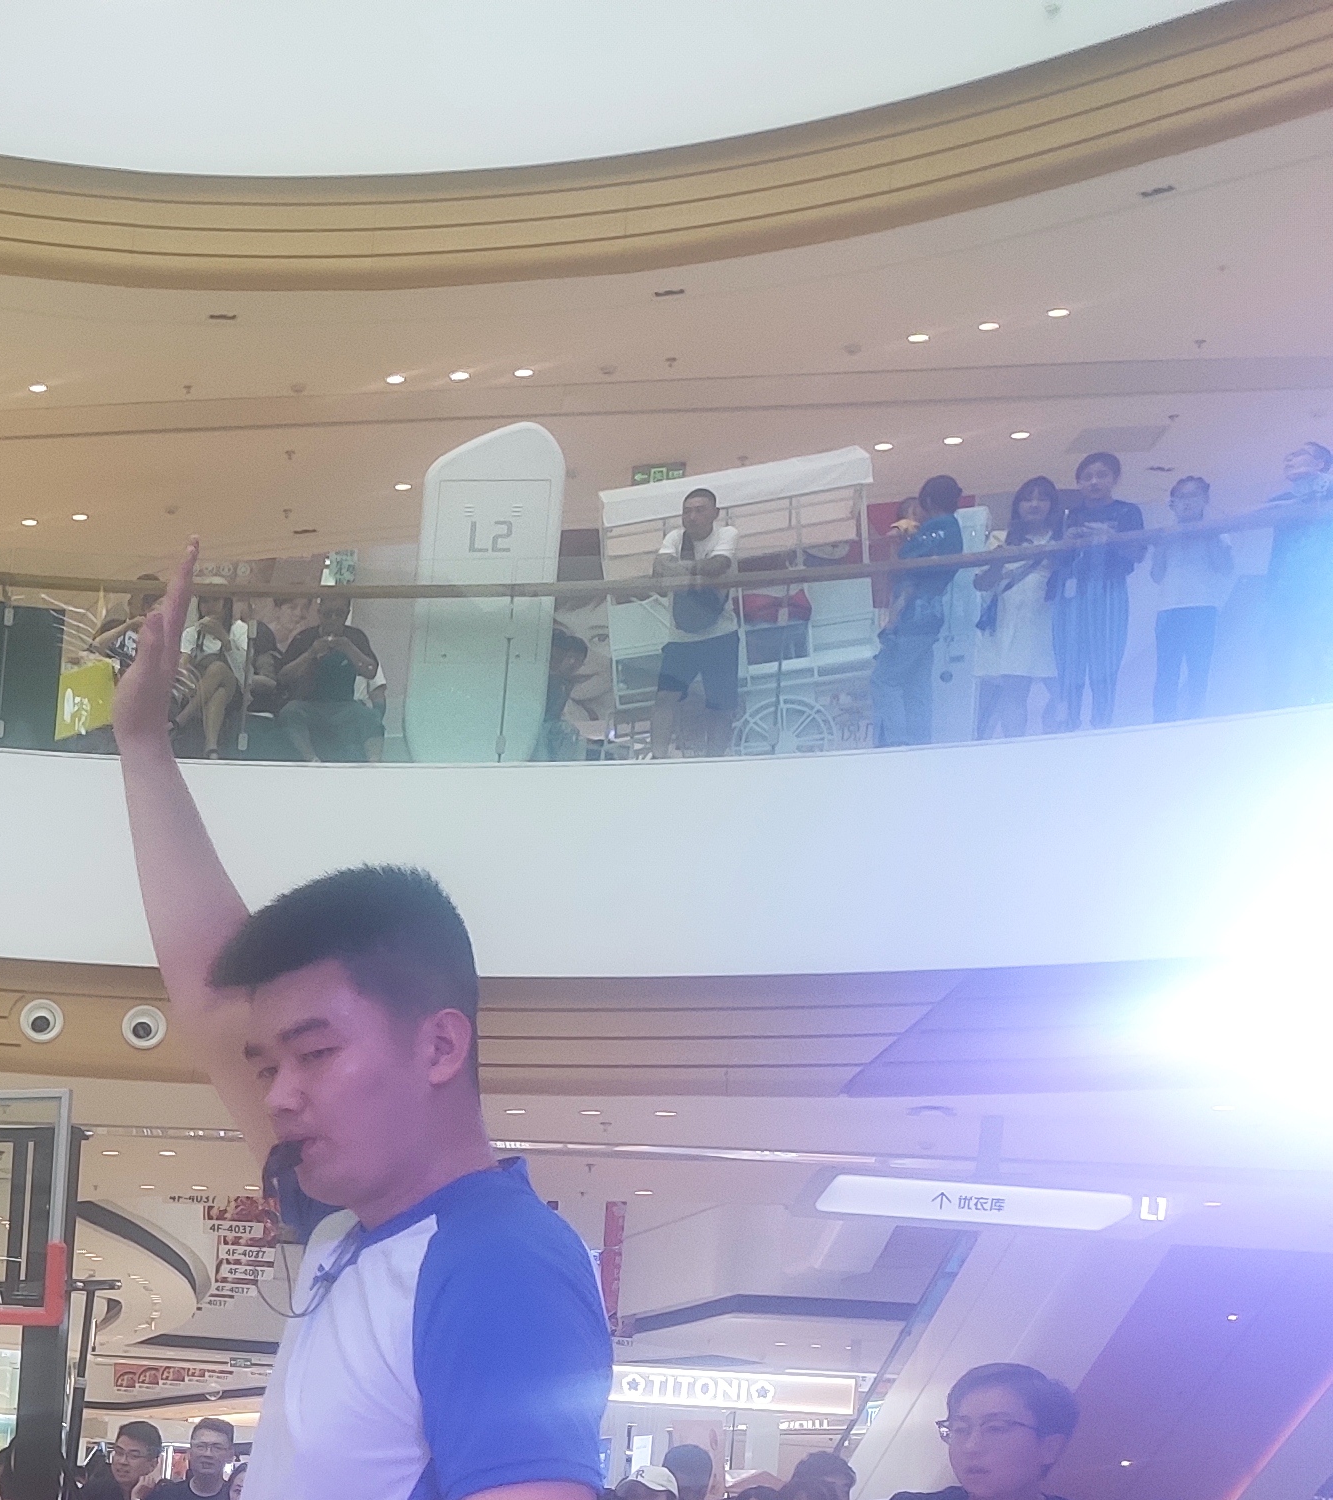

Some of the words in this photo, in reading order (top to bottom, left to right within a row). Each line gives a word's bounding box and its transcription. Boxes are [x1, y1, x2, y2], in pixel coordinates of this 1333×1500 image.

[468, 520, 513, 553] L2
[958, 1194, 1006, 1213] 优衣库
[210, 1224, 254, 1233] 4F-4037
[225, 1249, 266, 1258] 4F-4037
[648, 1373, 750, 1402] TITONI
